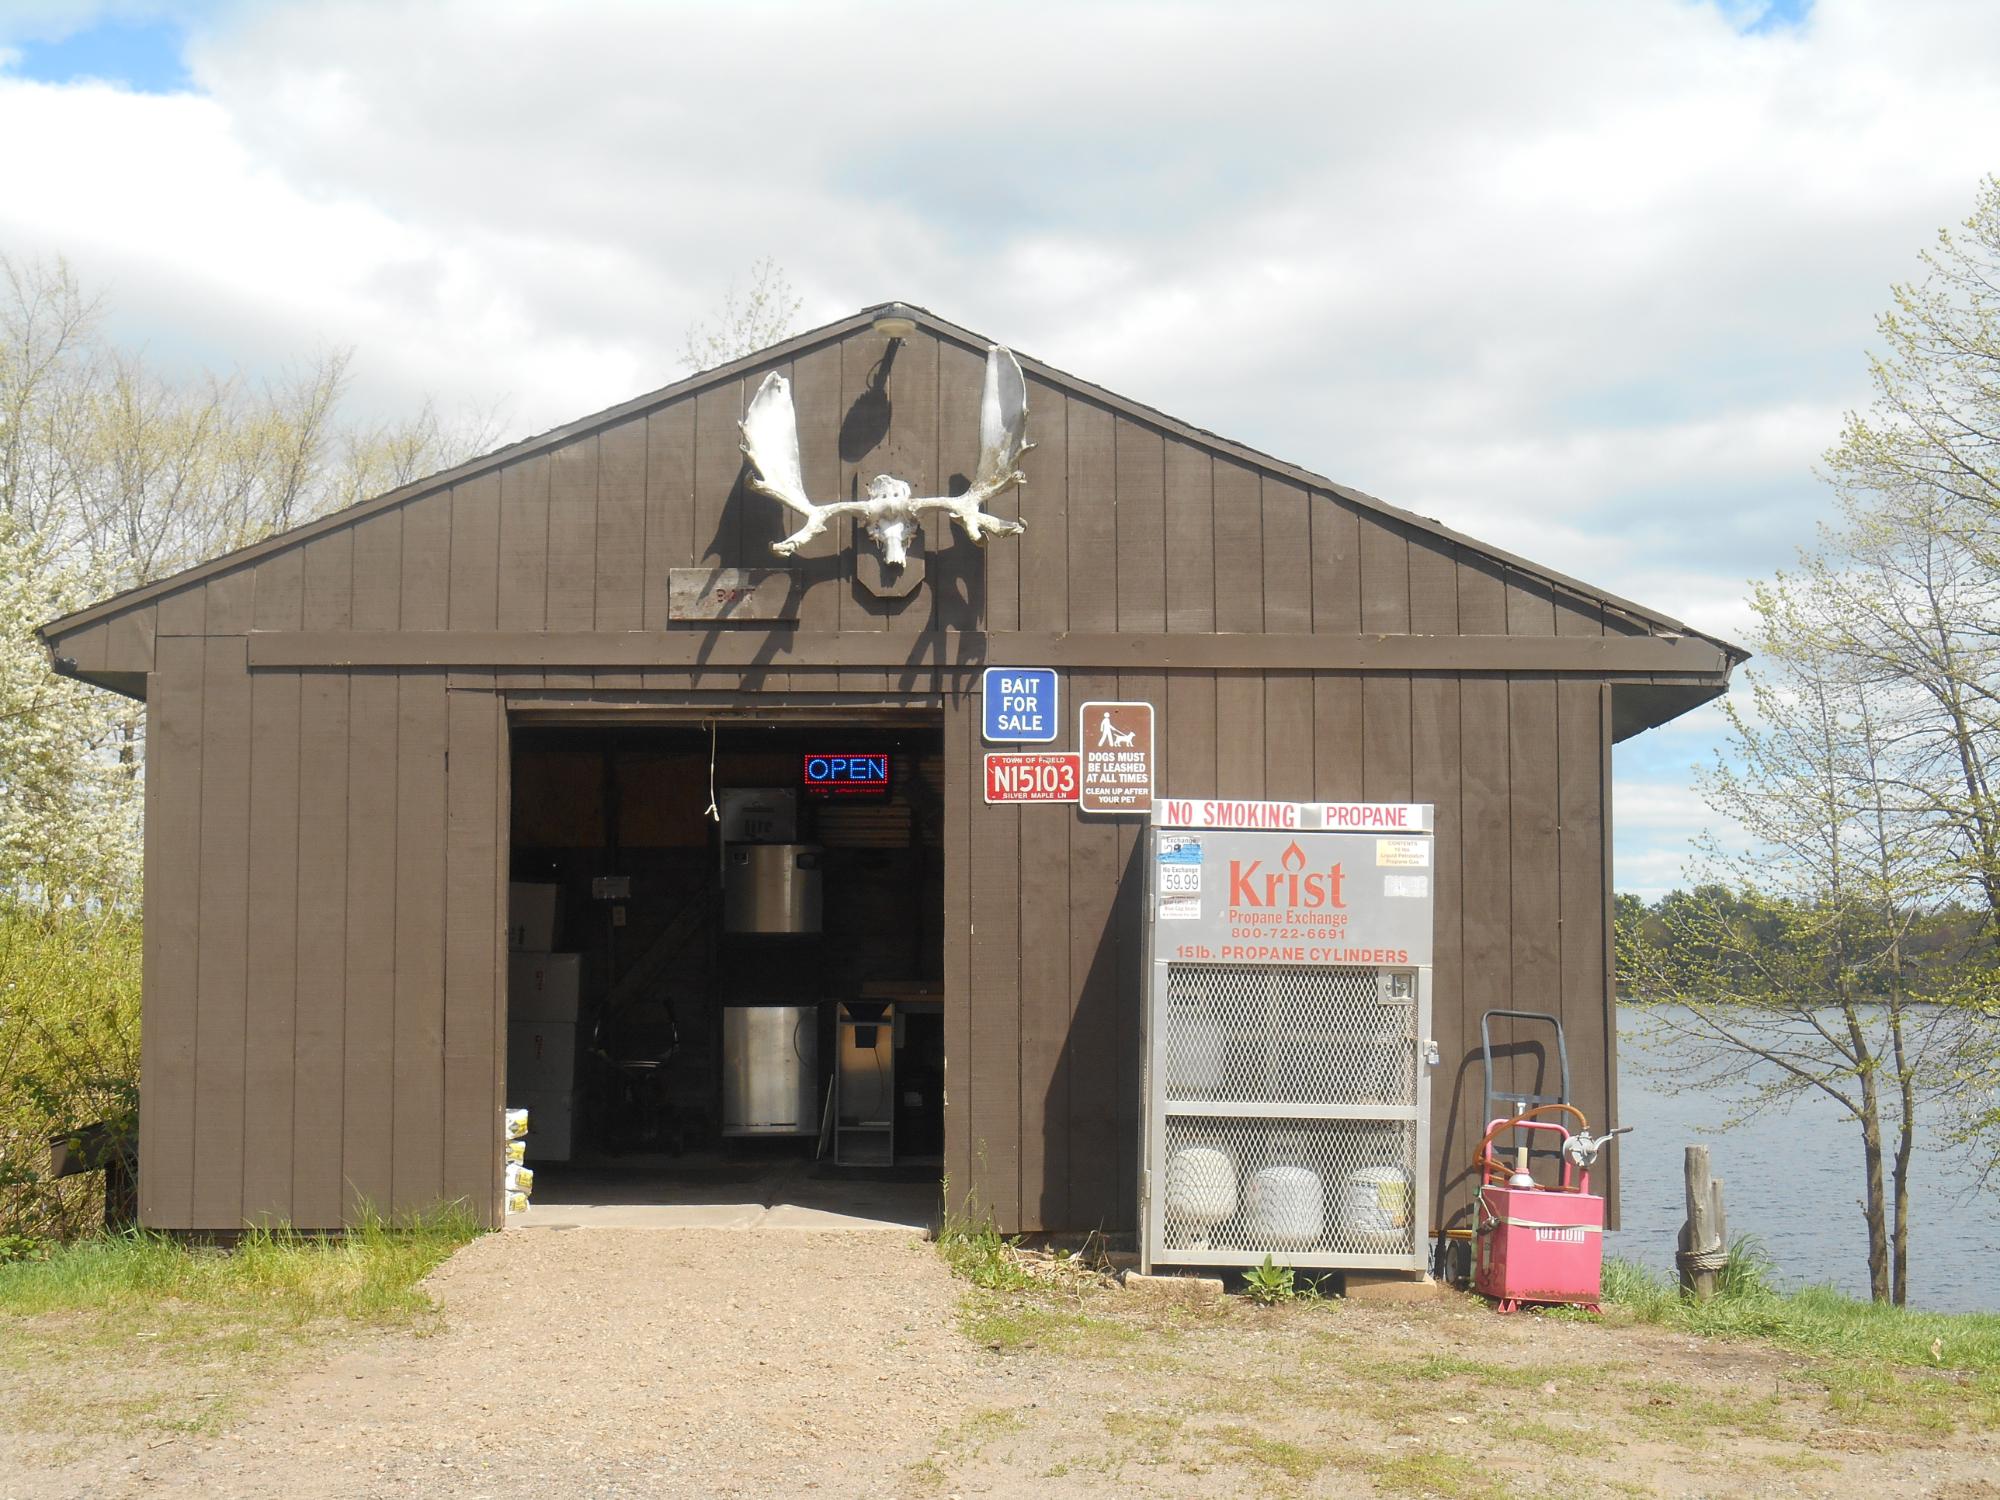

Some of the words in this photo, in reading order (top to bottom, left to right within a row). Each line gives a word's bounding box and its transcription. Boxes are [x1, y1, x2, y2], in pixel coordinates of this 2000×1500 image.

[1001, 678, 1040, 694] BAIT
[1003, 696, 1037, 712] FOR
[998, 714, 1043, 731] SALE
[1088, 752, 1116, 762] DOGS
[1117, 752, 1145, 762] MUST
[808, 758, 884, 779] OPEN
[1088, 762, 1101, 773] BE
[1103, 762, 1146, 773] LEASHED
[994, 765, 1075, 793] N15103
[1086, 773, 1098, 783] AT
[1100, 773, 1118, 783] ALL
[1119, 773, 1149, 783] TIMES
[1085, 787, 1111, 795] CLEAN
[1167, 801, 1193, 825] NO
[1203, 801, 1295, 828] SMOKING
[1326, 806, 1408, 827] PROPANE
[1228, 860, 1347, 909] Krist
[1229, 910, 1282, 926] Propane
[1286, 910, 1348, 928] Exchange
[1231, 928, 1345, 940] 800-722-6691
[1176, 945, 1216, 959] 15lb.
[1221, 945, 1305, 961] PROPANE
[1310, 947, 1408, 963] CYLINDERS
